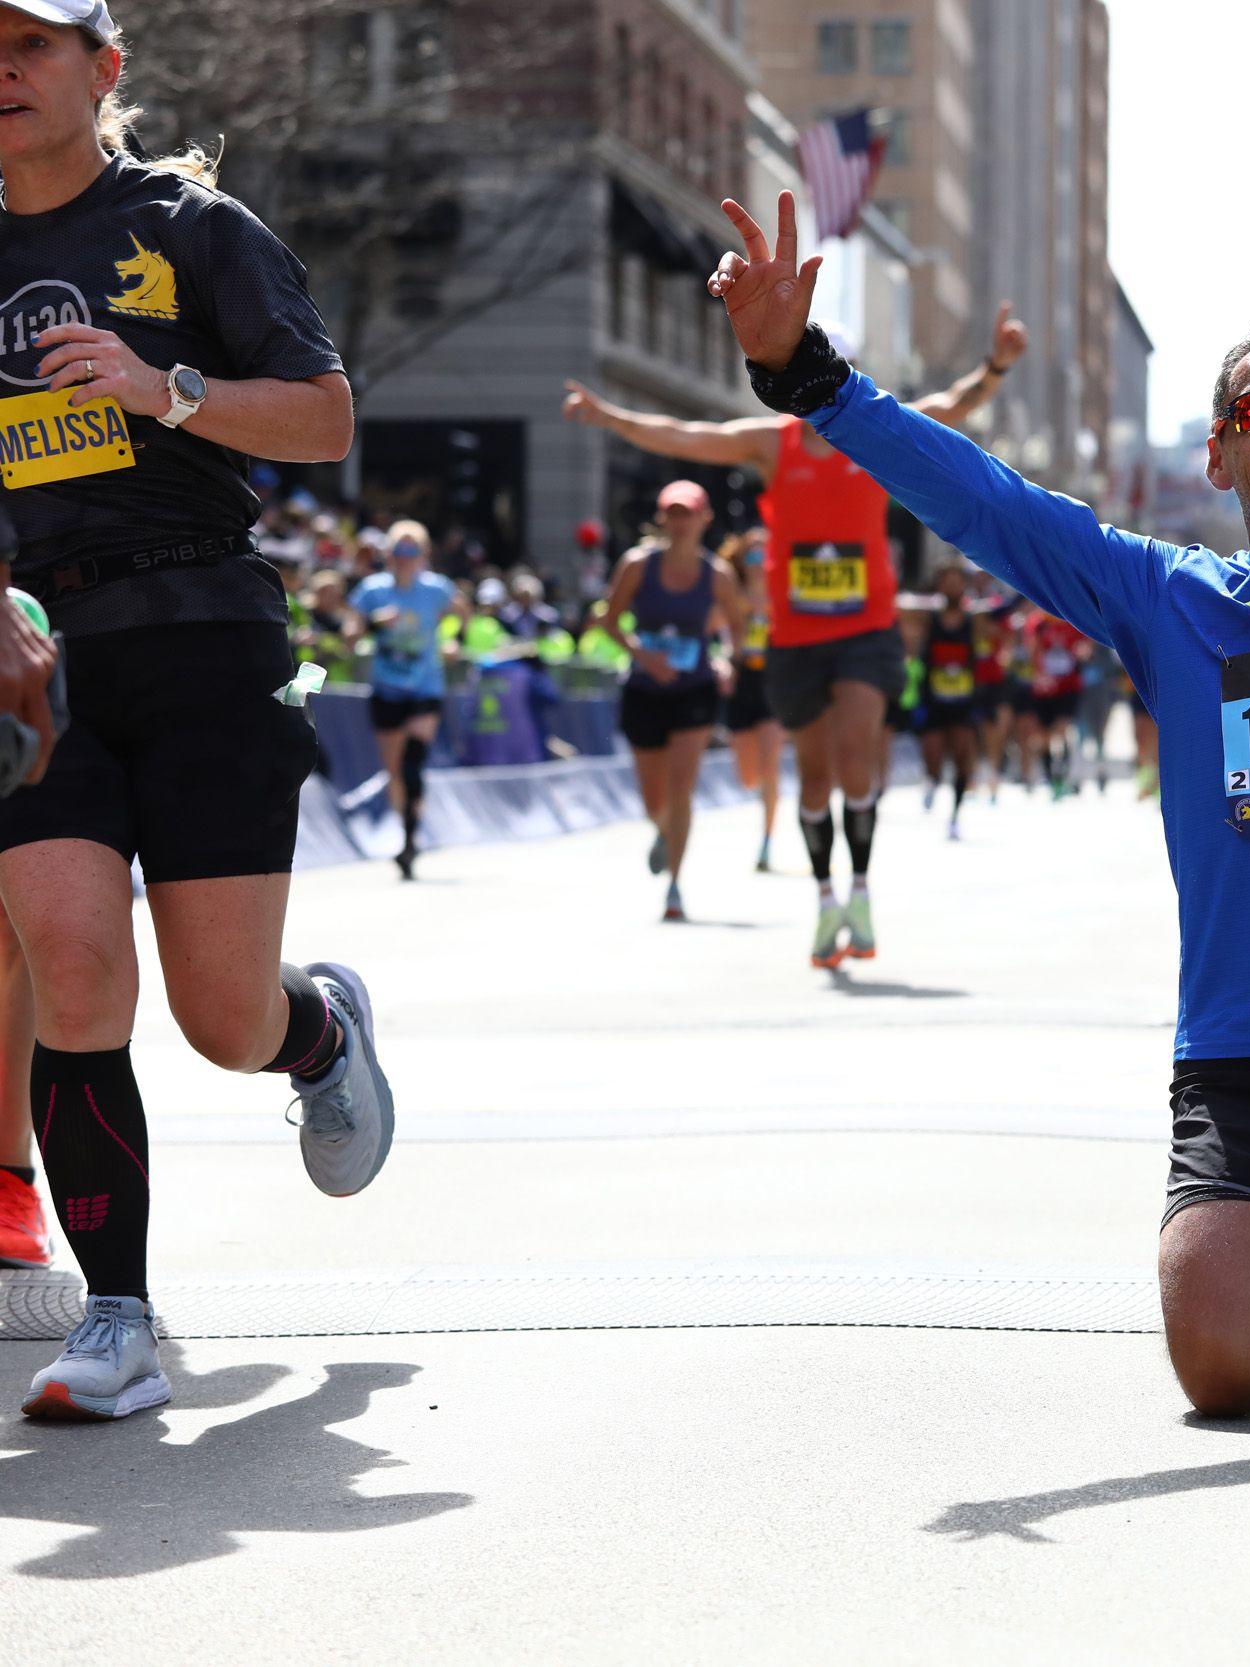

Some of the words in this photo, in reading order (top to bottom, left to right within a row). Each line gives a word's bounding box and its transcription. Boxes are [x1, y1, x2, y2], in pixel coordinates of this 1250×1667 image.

[0, 406, 128, 465] MELISSA
[132, 536, 235, 570] SPIBET
[1231, 771, 1247, 790] 2
[94, 1300, 121, 1309] HOKA
